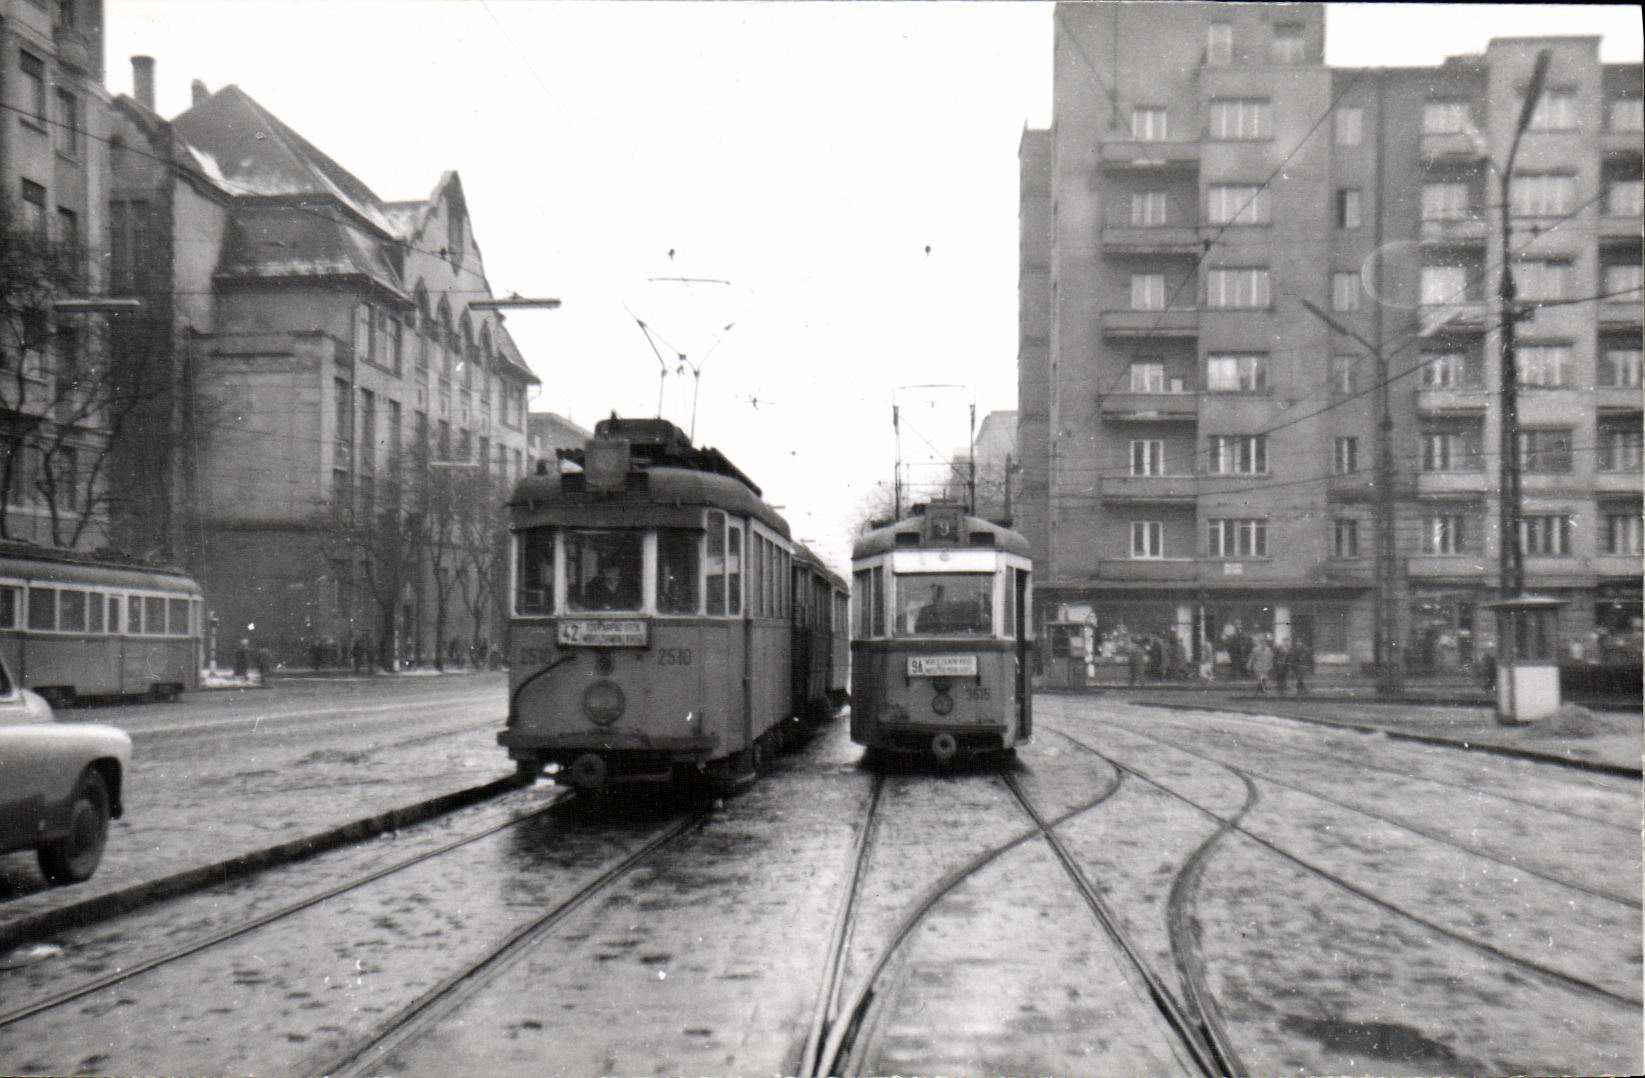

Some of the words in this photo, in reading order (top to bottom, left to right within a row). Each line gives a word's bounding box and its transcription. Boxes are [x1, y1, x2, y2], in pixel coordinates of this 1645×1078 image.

[563, 623, 579, 642] 42
[658, 648, 692, 666] 2510
[911, 660, 924, 673] 9A
[966, 687, 991, 702] 3615
